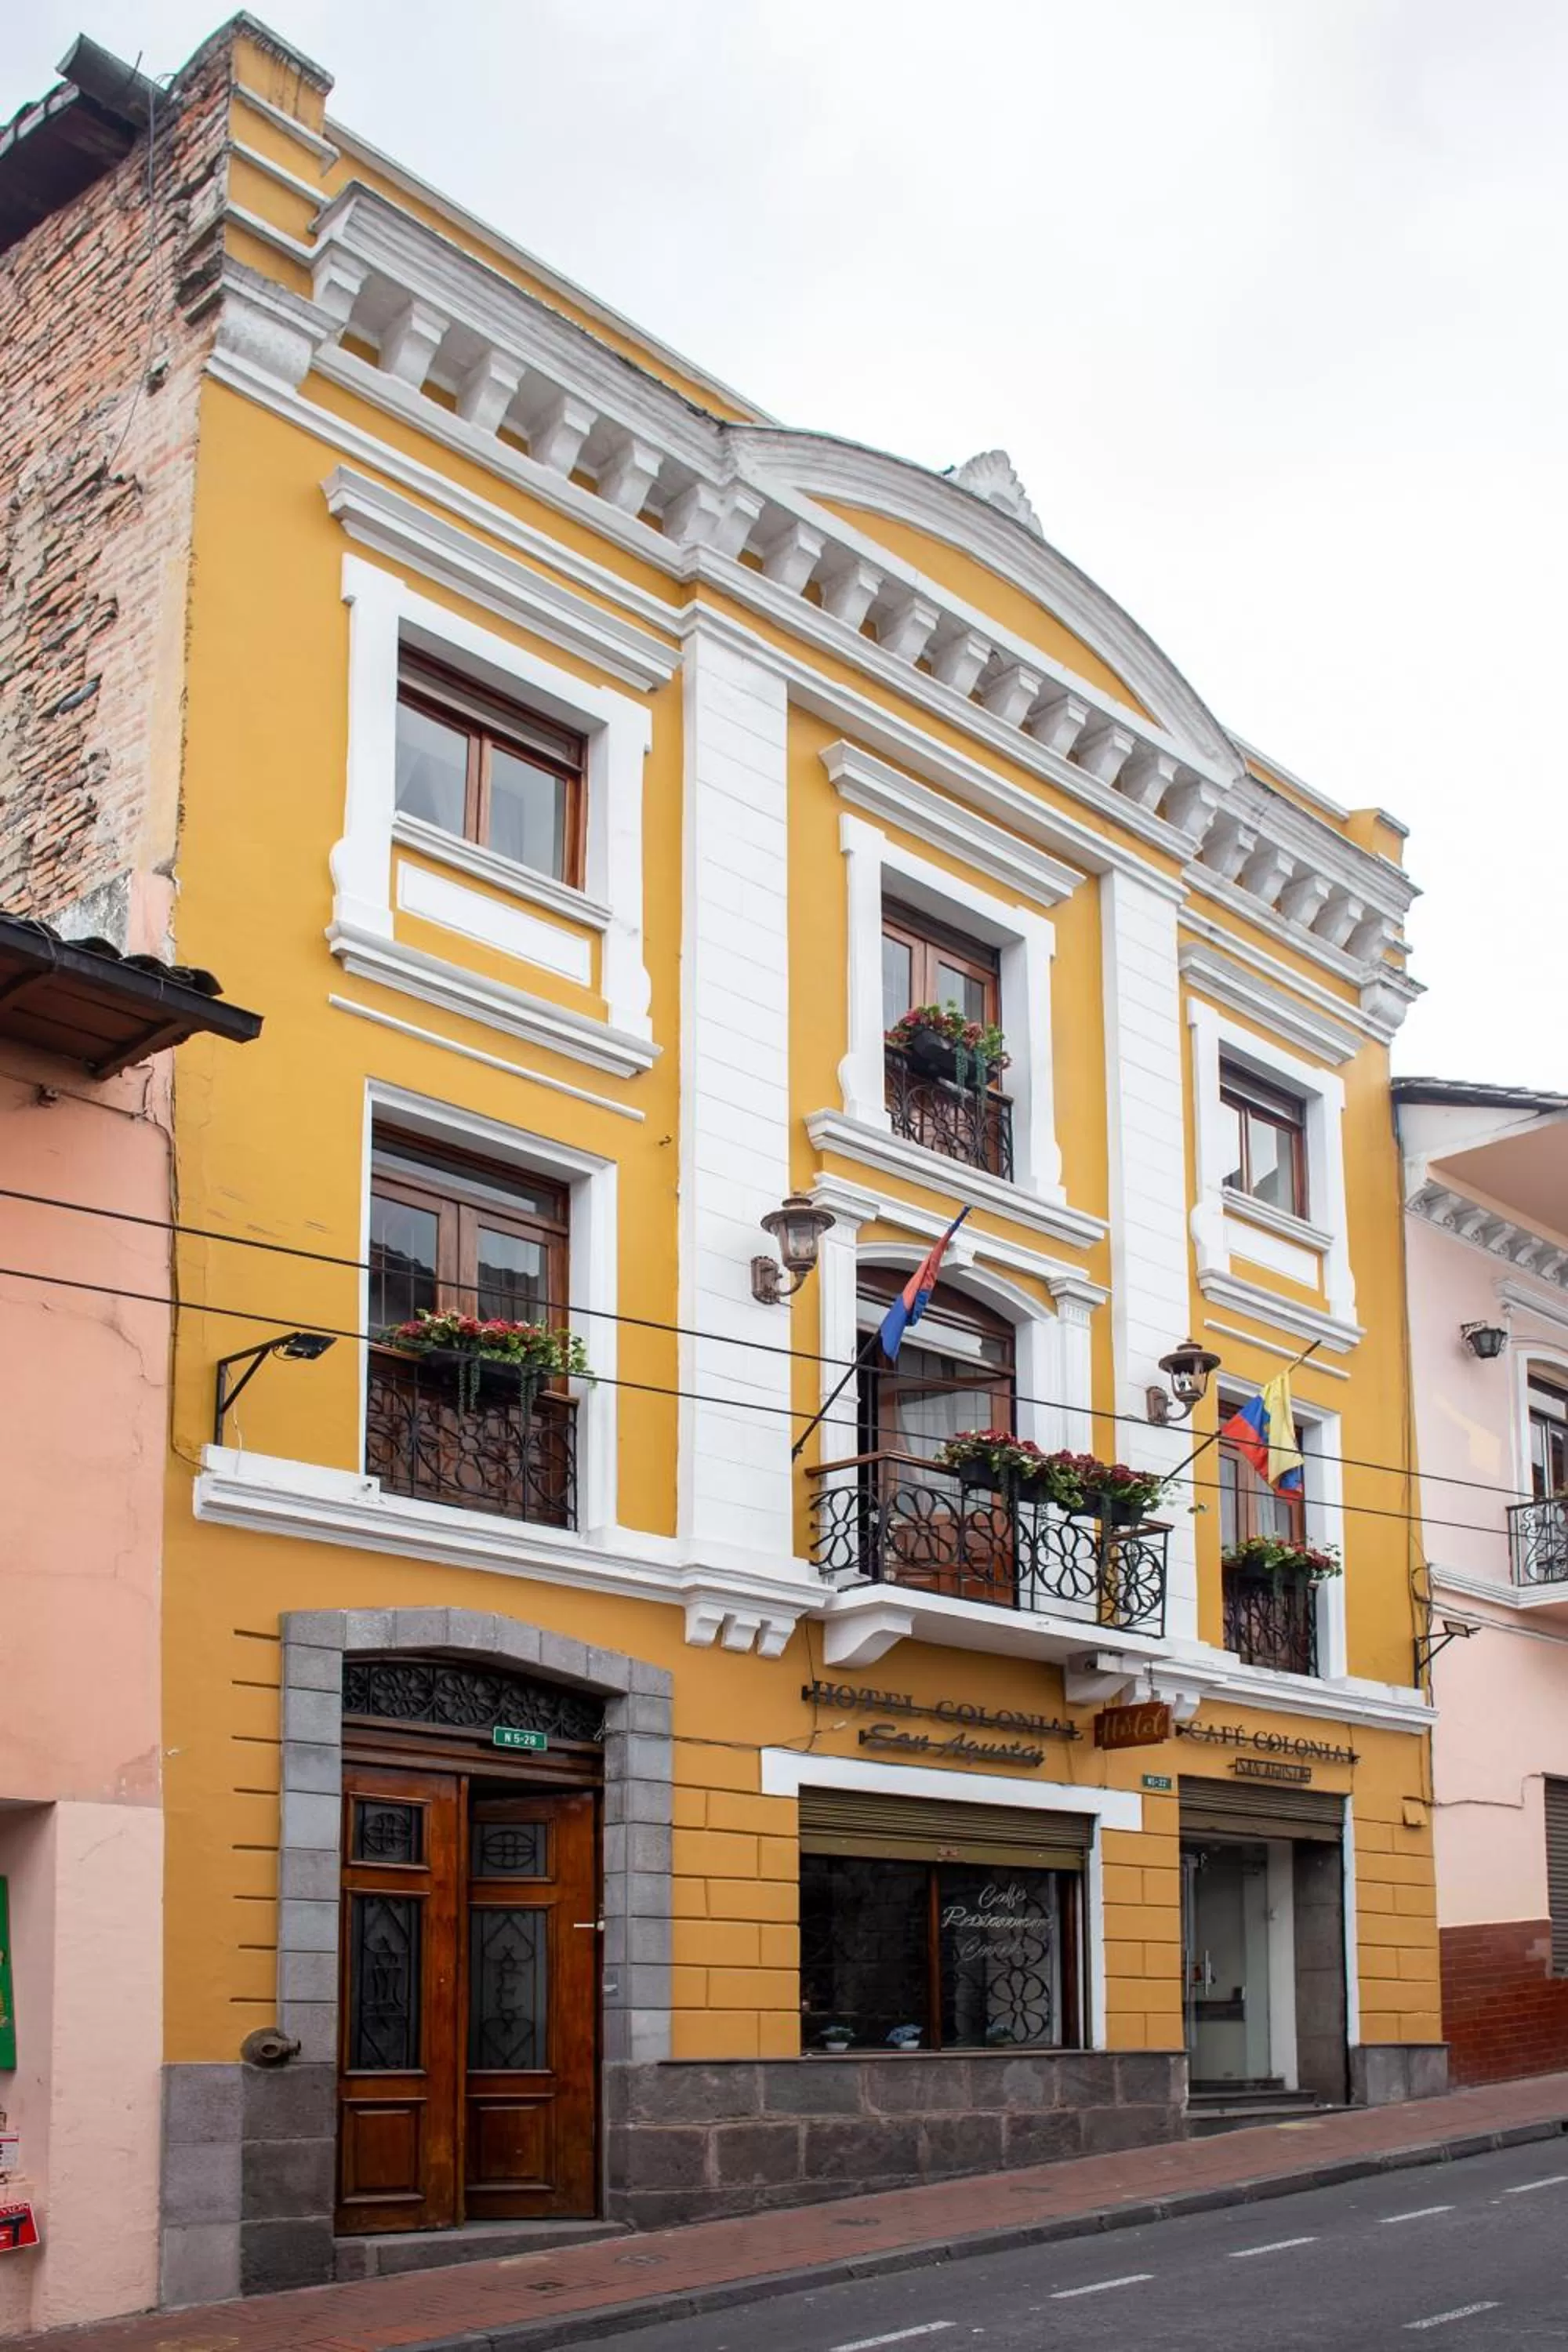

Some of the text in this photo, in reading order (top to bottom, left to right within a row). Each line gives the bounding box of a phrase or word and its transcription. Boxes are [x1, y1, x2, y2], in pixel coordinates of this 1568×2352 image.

[812, 1680, 1083, 1740] HOTEL COLONIAL
[1098, 1707, 1166, 1743] Hotel
[504, 1732, 537, 1746] N 5-28
[866, 1723, 929, 1751] San
[1188, 1720, 1359, 1765] CAFÉ COLONIAL
